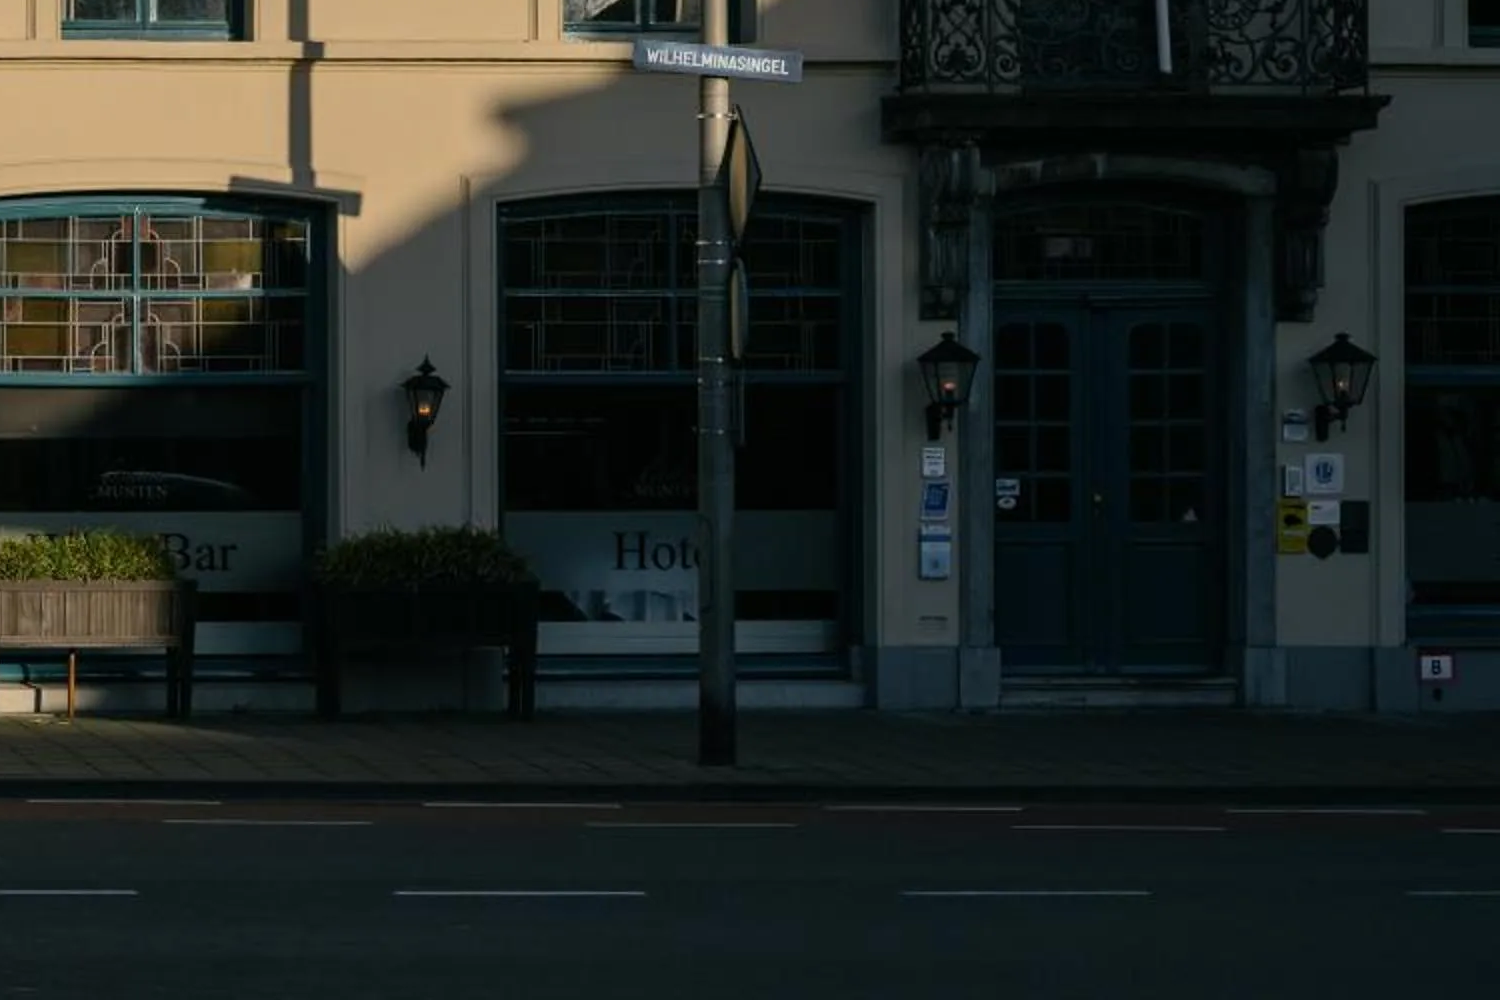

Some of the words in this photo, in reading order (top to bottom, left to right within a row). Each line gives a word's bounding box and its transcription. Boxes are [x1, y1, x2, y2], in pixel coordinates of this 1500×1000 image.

[646, 47, 790, 76] WILHELMINASINGEL
[160, 533, 238, 572] Bar
[610, 531, 700, 571] Hot
